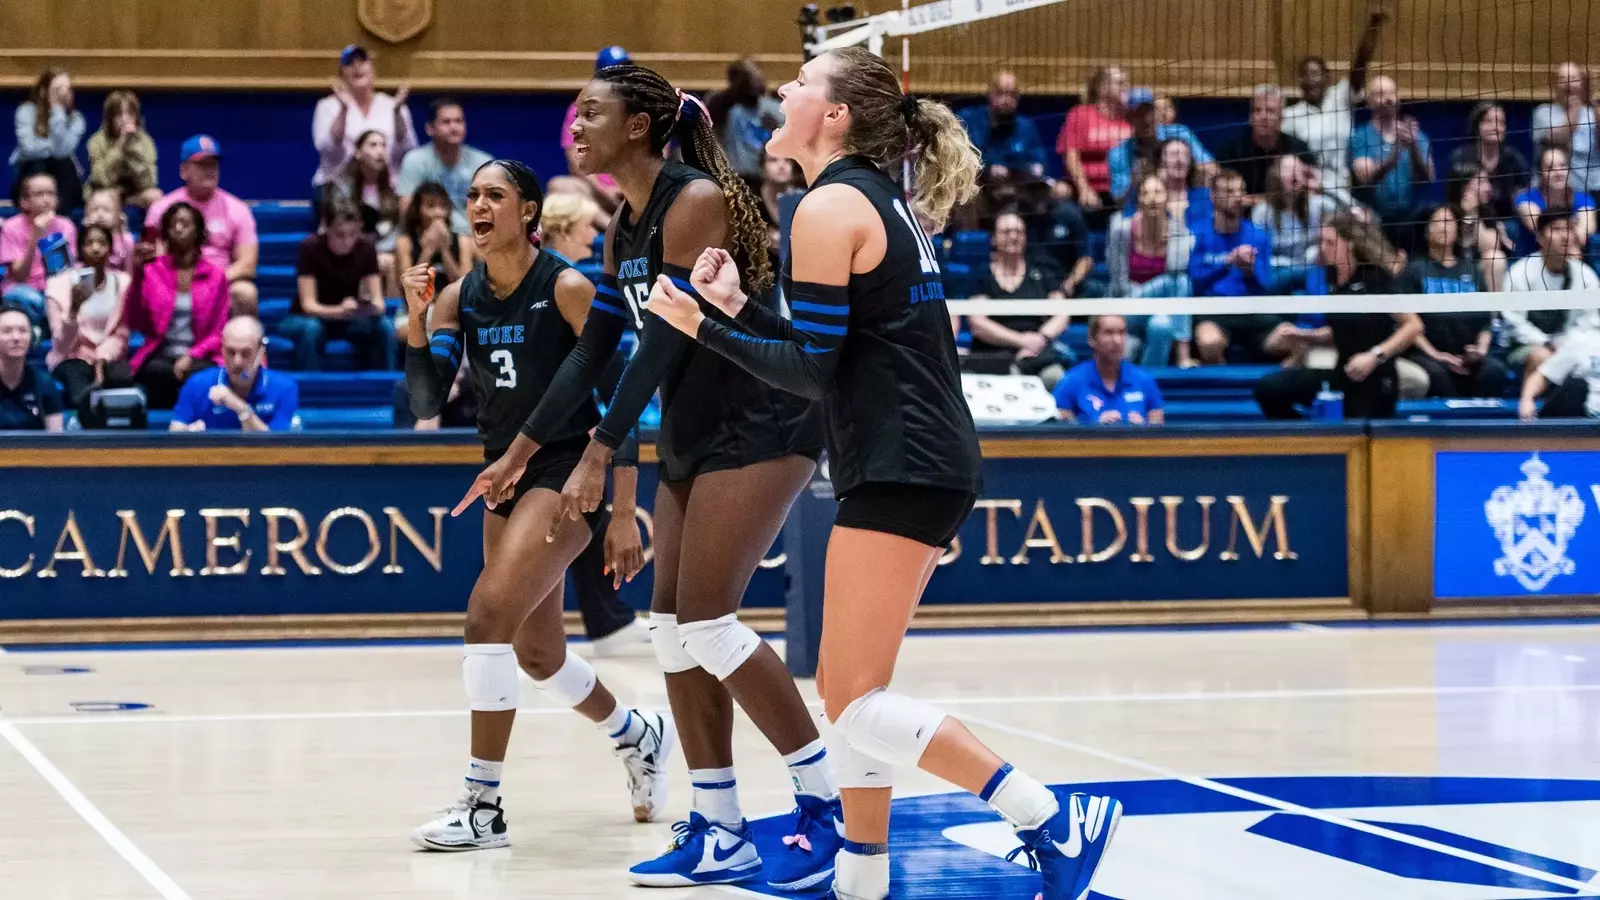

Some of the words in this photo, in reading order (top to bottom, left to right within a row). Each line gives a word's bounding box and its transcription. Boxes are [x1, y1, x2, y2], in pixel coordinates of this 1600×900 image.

[477, 325, 525, 345] DUKE
[490, 349, 518, 389] 3
[0, 506, 449, 579] CAMERON
